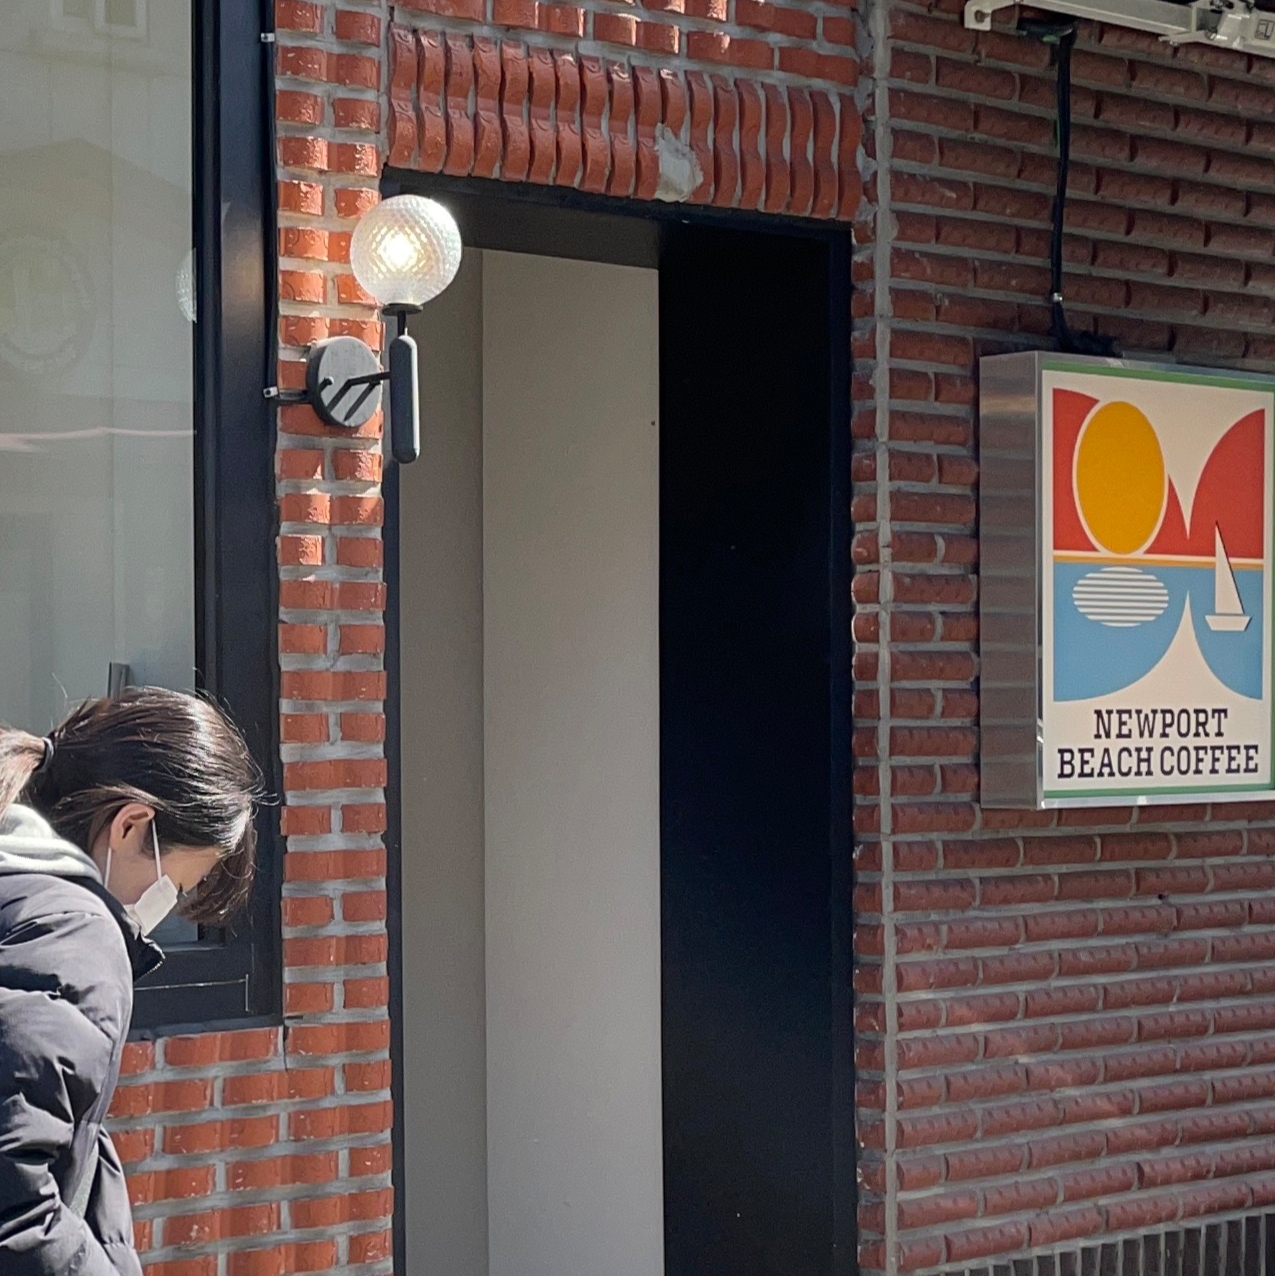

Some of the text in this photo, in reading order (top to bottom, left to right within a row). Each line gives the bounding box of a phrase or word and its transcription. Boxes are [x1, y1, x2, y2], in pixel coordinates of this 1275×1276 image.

[1093, 708, 1228, 740] NEWPORT
[1057, 744, 1259, 779] BEACH COFFEE
